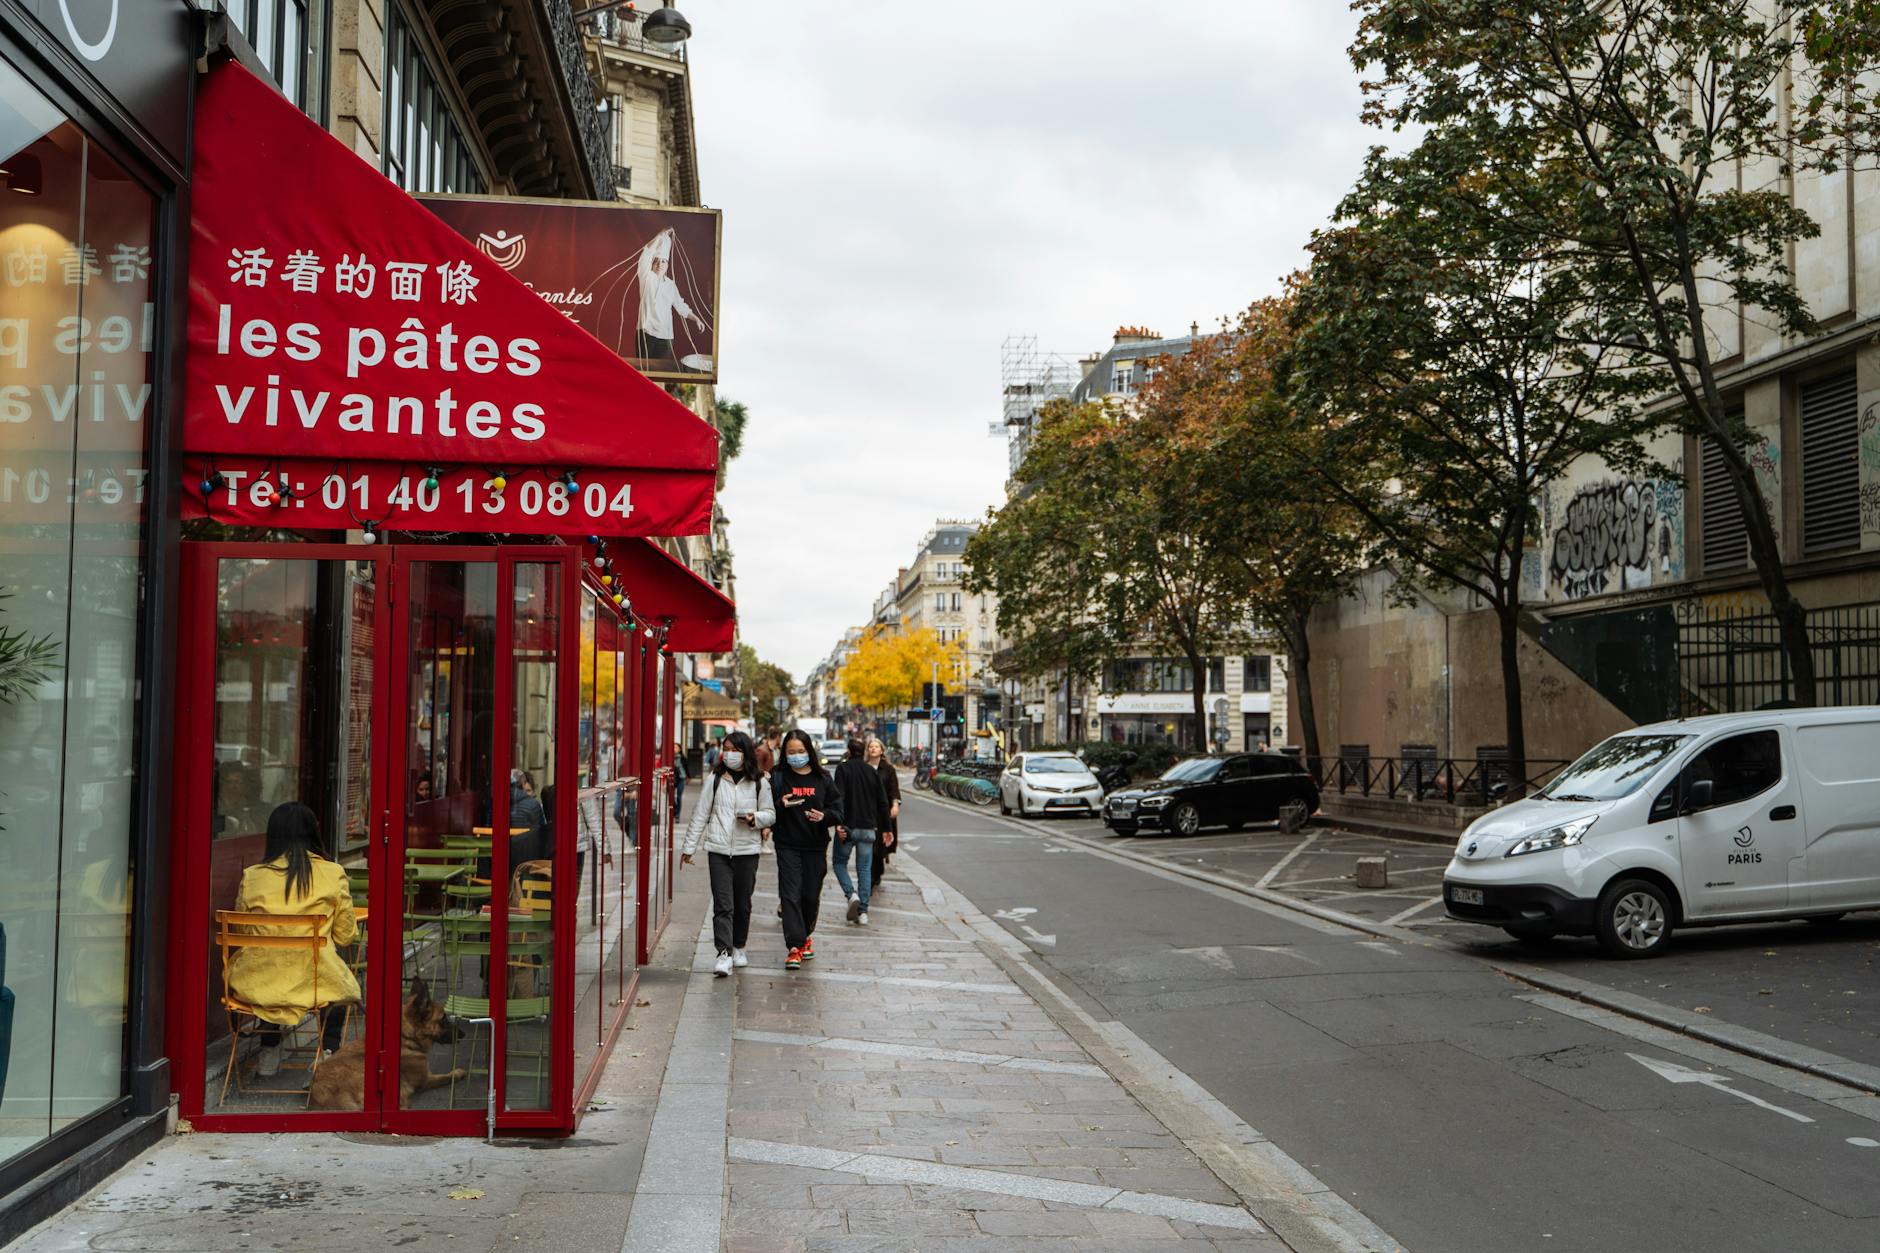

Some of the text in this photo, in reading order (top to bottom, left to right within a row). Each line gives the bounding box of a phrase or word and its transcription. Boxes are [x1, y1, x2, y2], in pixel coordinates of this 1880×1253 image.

[218, 304, 541, 377] les pâtes
[216, 375, 545, 440] vivantes
[323, 475, 368, 510] 01
[388, 477, 439, 513] 40
[457, 479, 506, 514] 13
[520, 481, 569, 516] 08
[584, 483, 634, 518] 04
[1728, 853, 1762, 864] PARIS
